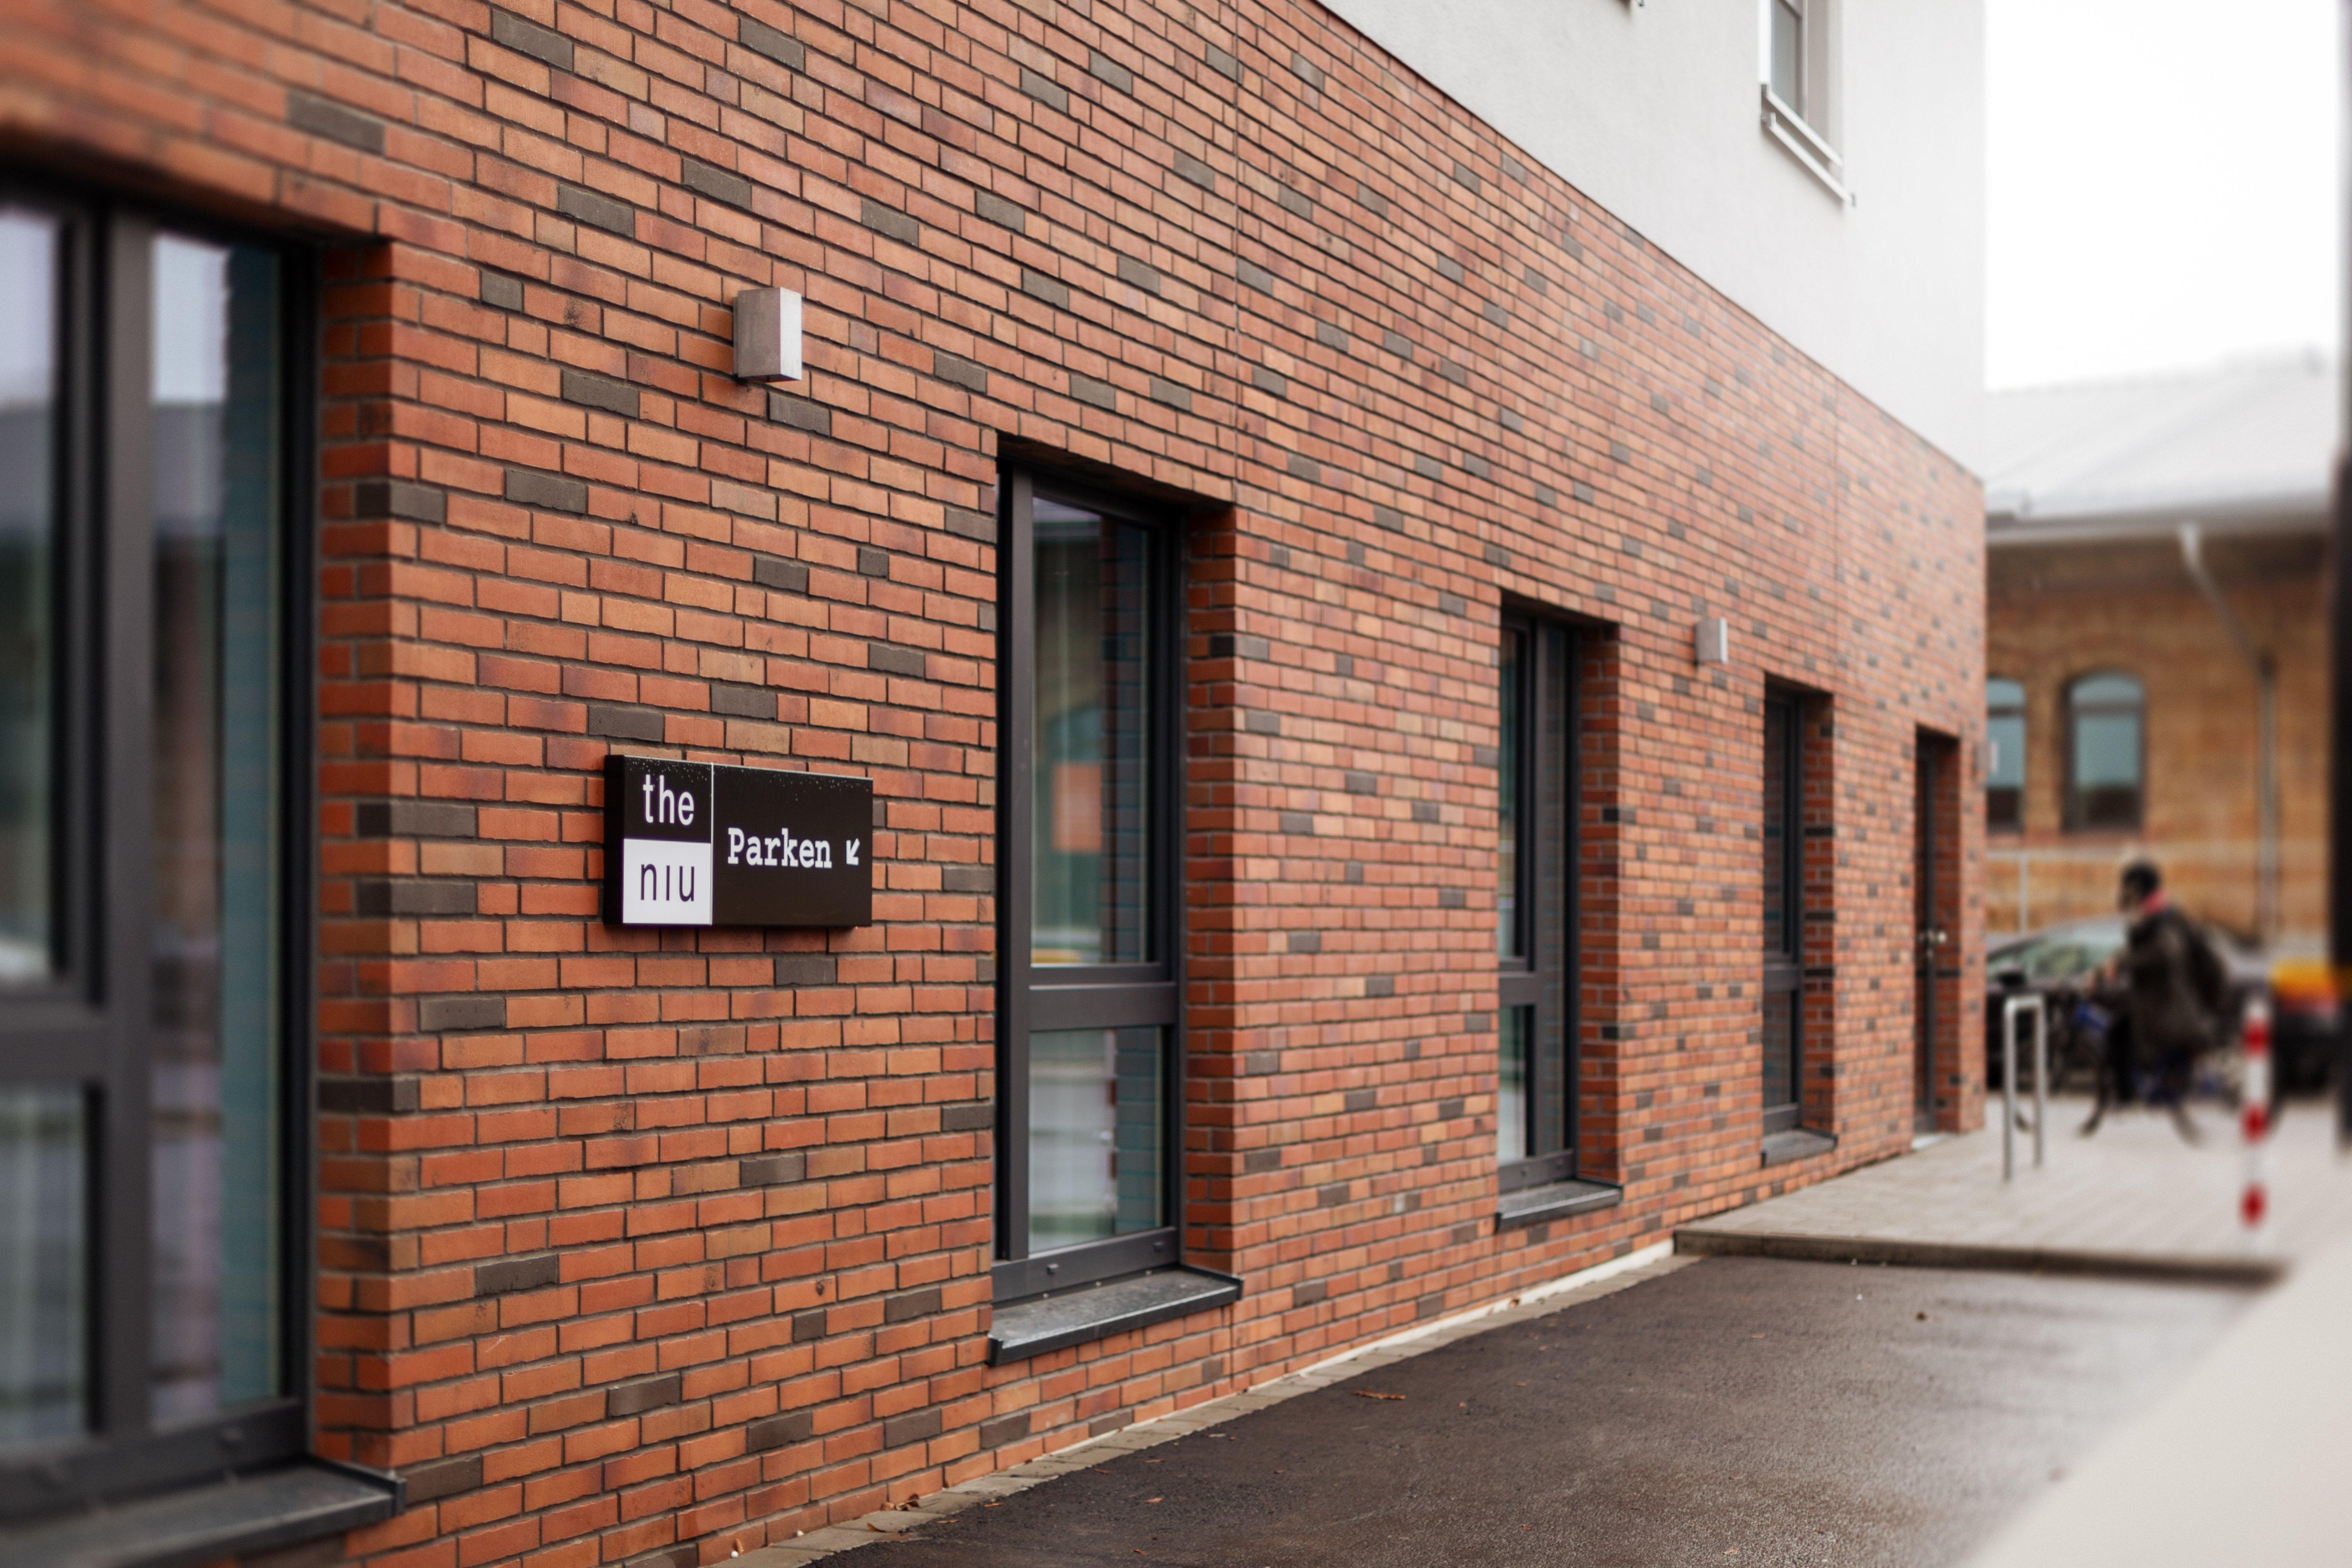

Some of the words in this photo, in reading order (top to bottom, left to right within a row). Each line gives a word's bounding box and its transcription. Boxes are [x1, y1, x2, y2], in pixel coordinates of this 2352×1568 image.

[643, 774, 694, 826] the
[727, 827, 833, 869] Parken
[640, 863, 694, 902] niu
